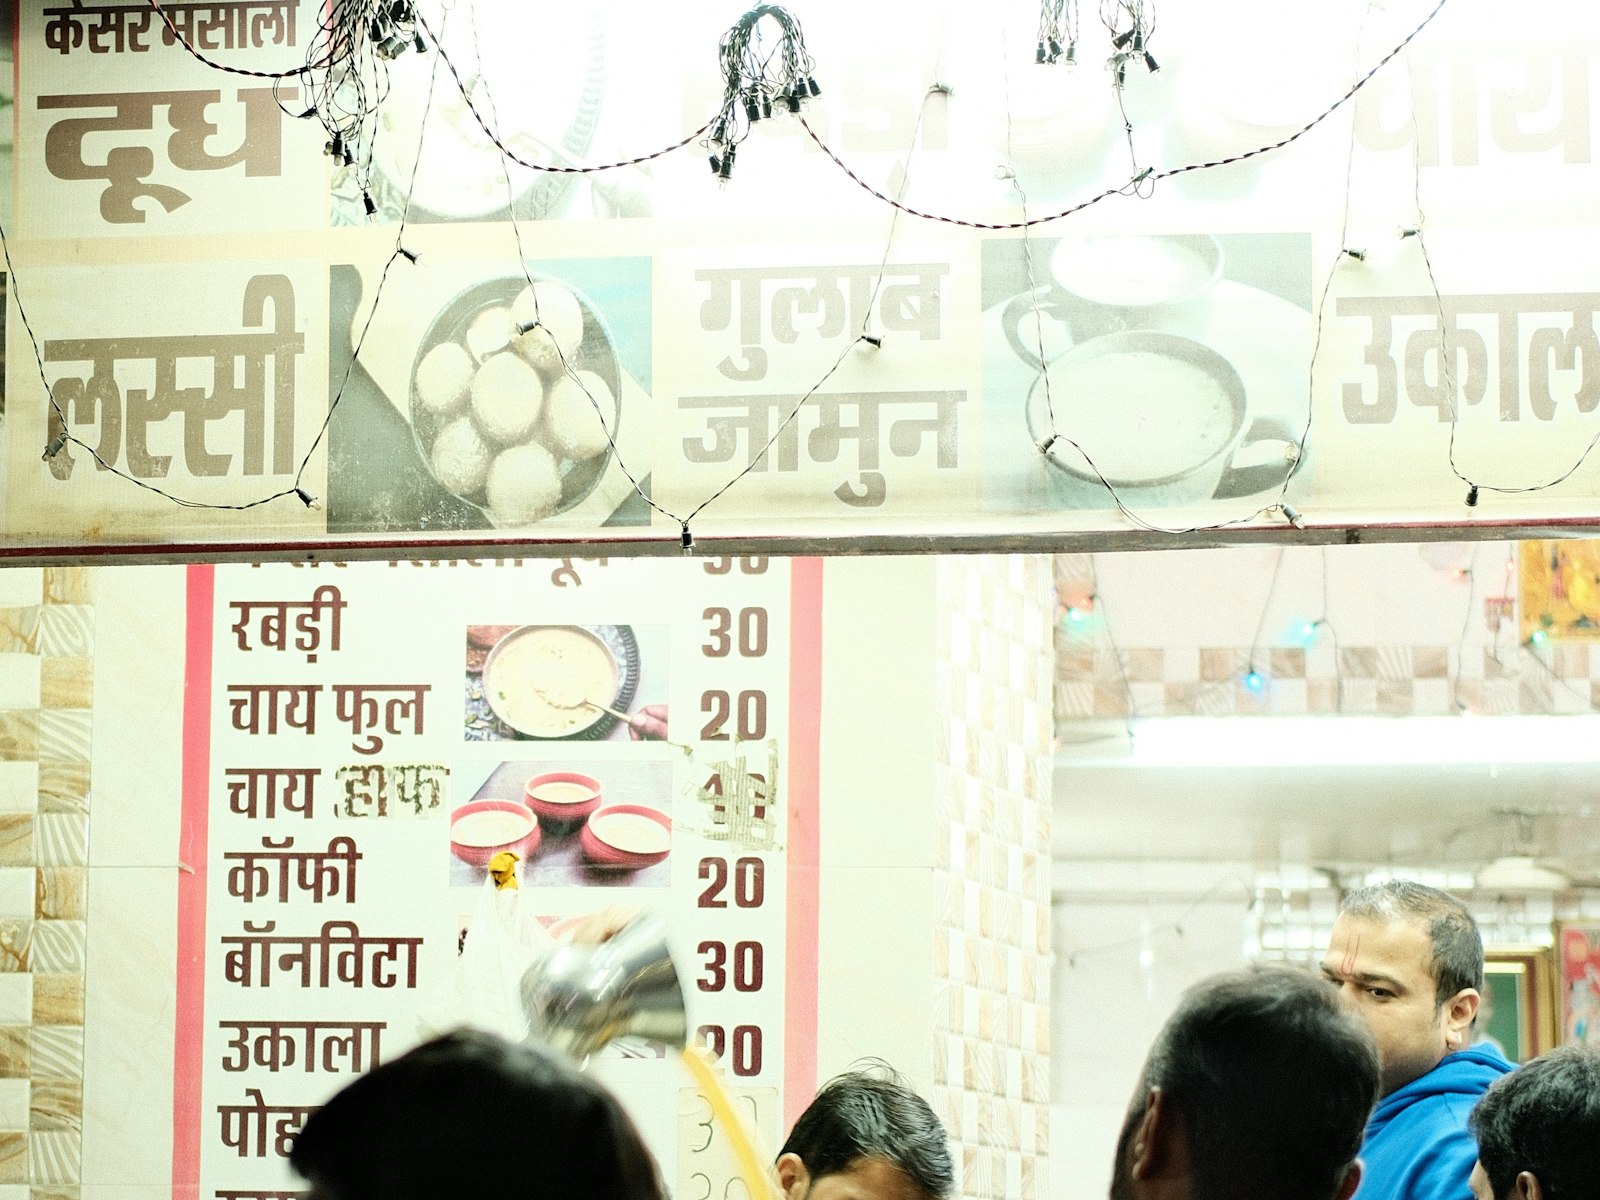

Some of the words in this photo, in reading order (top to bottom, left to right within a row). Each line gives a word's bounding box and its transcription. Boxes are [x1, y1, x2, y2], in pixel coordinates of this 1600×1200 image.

[150, 1, 300, 51] मसाला
[36, 87, 300, 224] दूध
[694, 262, 950, 382] गुलाब
[44, 273, 305, 482] लस्सी
[1336, 292, 1600, 425] उकाल
[677, 389, 968, 508] जामुन
[229, 585, 348, 664] रबड़ी
[701, 607, 768, 657] 30
[227, 685, 323, 735] चाय
[332, 685, 431, 755] फुल
[700, 690, 767, 740] 20
[225, 768, 321, 818] चाय
[223, 836, 363, 903] कॉफी
[698, 857, 764, 908] 20
[221, 920, 424, 989] बॉनविटा
[697, 941, 764, 992] 30
[219, 1020, 387, 1073] उकाला
[217, 1088, 322, 1157] पोह
